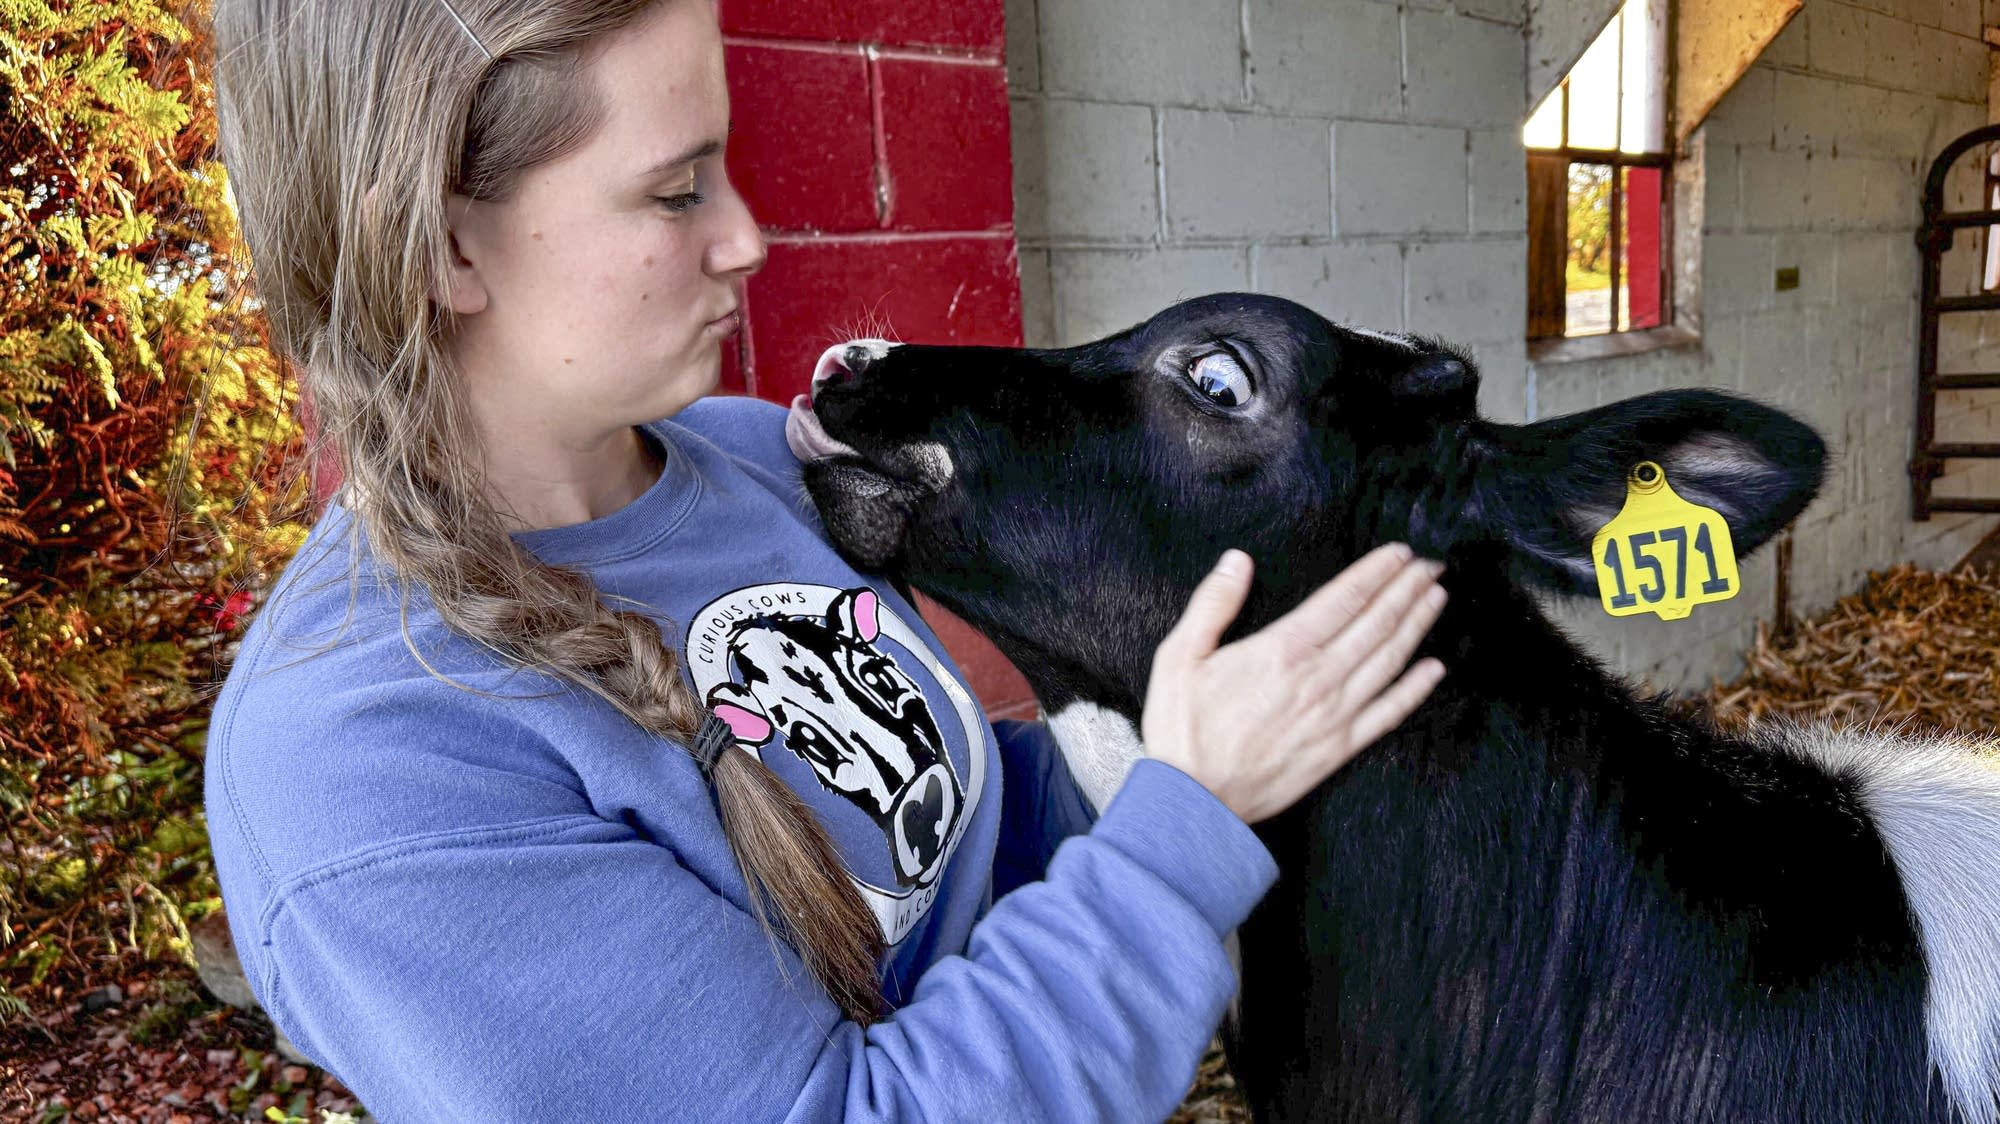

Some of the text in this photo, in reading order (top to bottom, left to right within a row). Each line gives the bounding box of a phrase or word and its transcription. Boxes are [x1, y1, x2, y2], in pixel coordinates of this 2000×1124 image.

[1603, 522, 1730, 609] 1571
[698, 591, 806, 663] CURIOUS COWS
